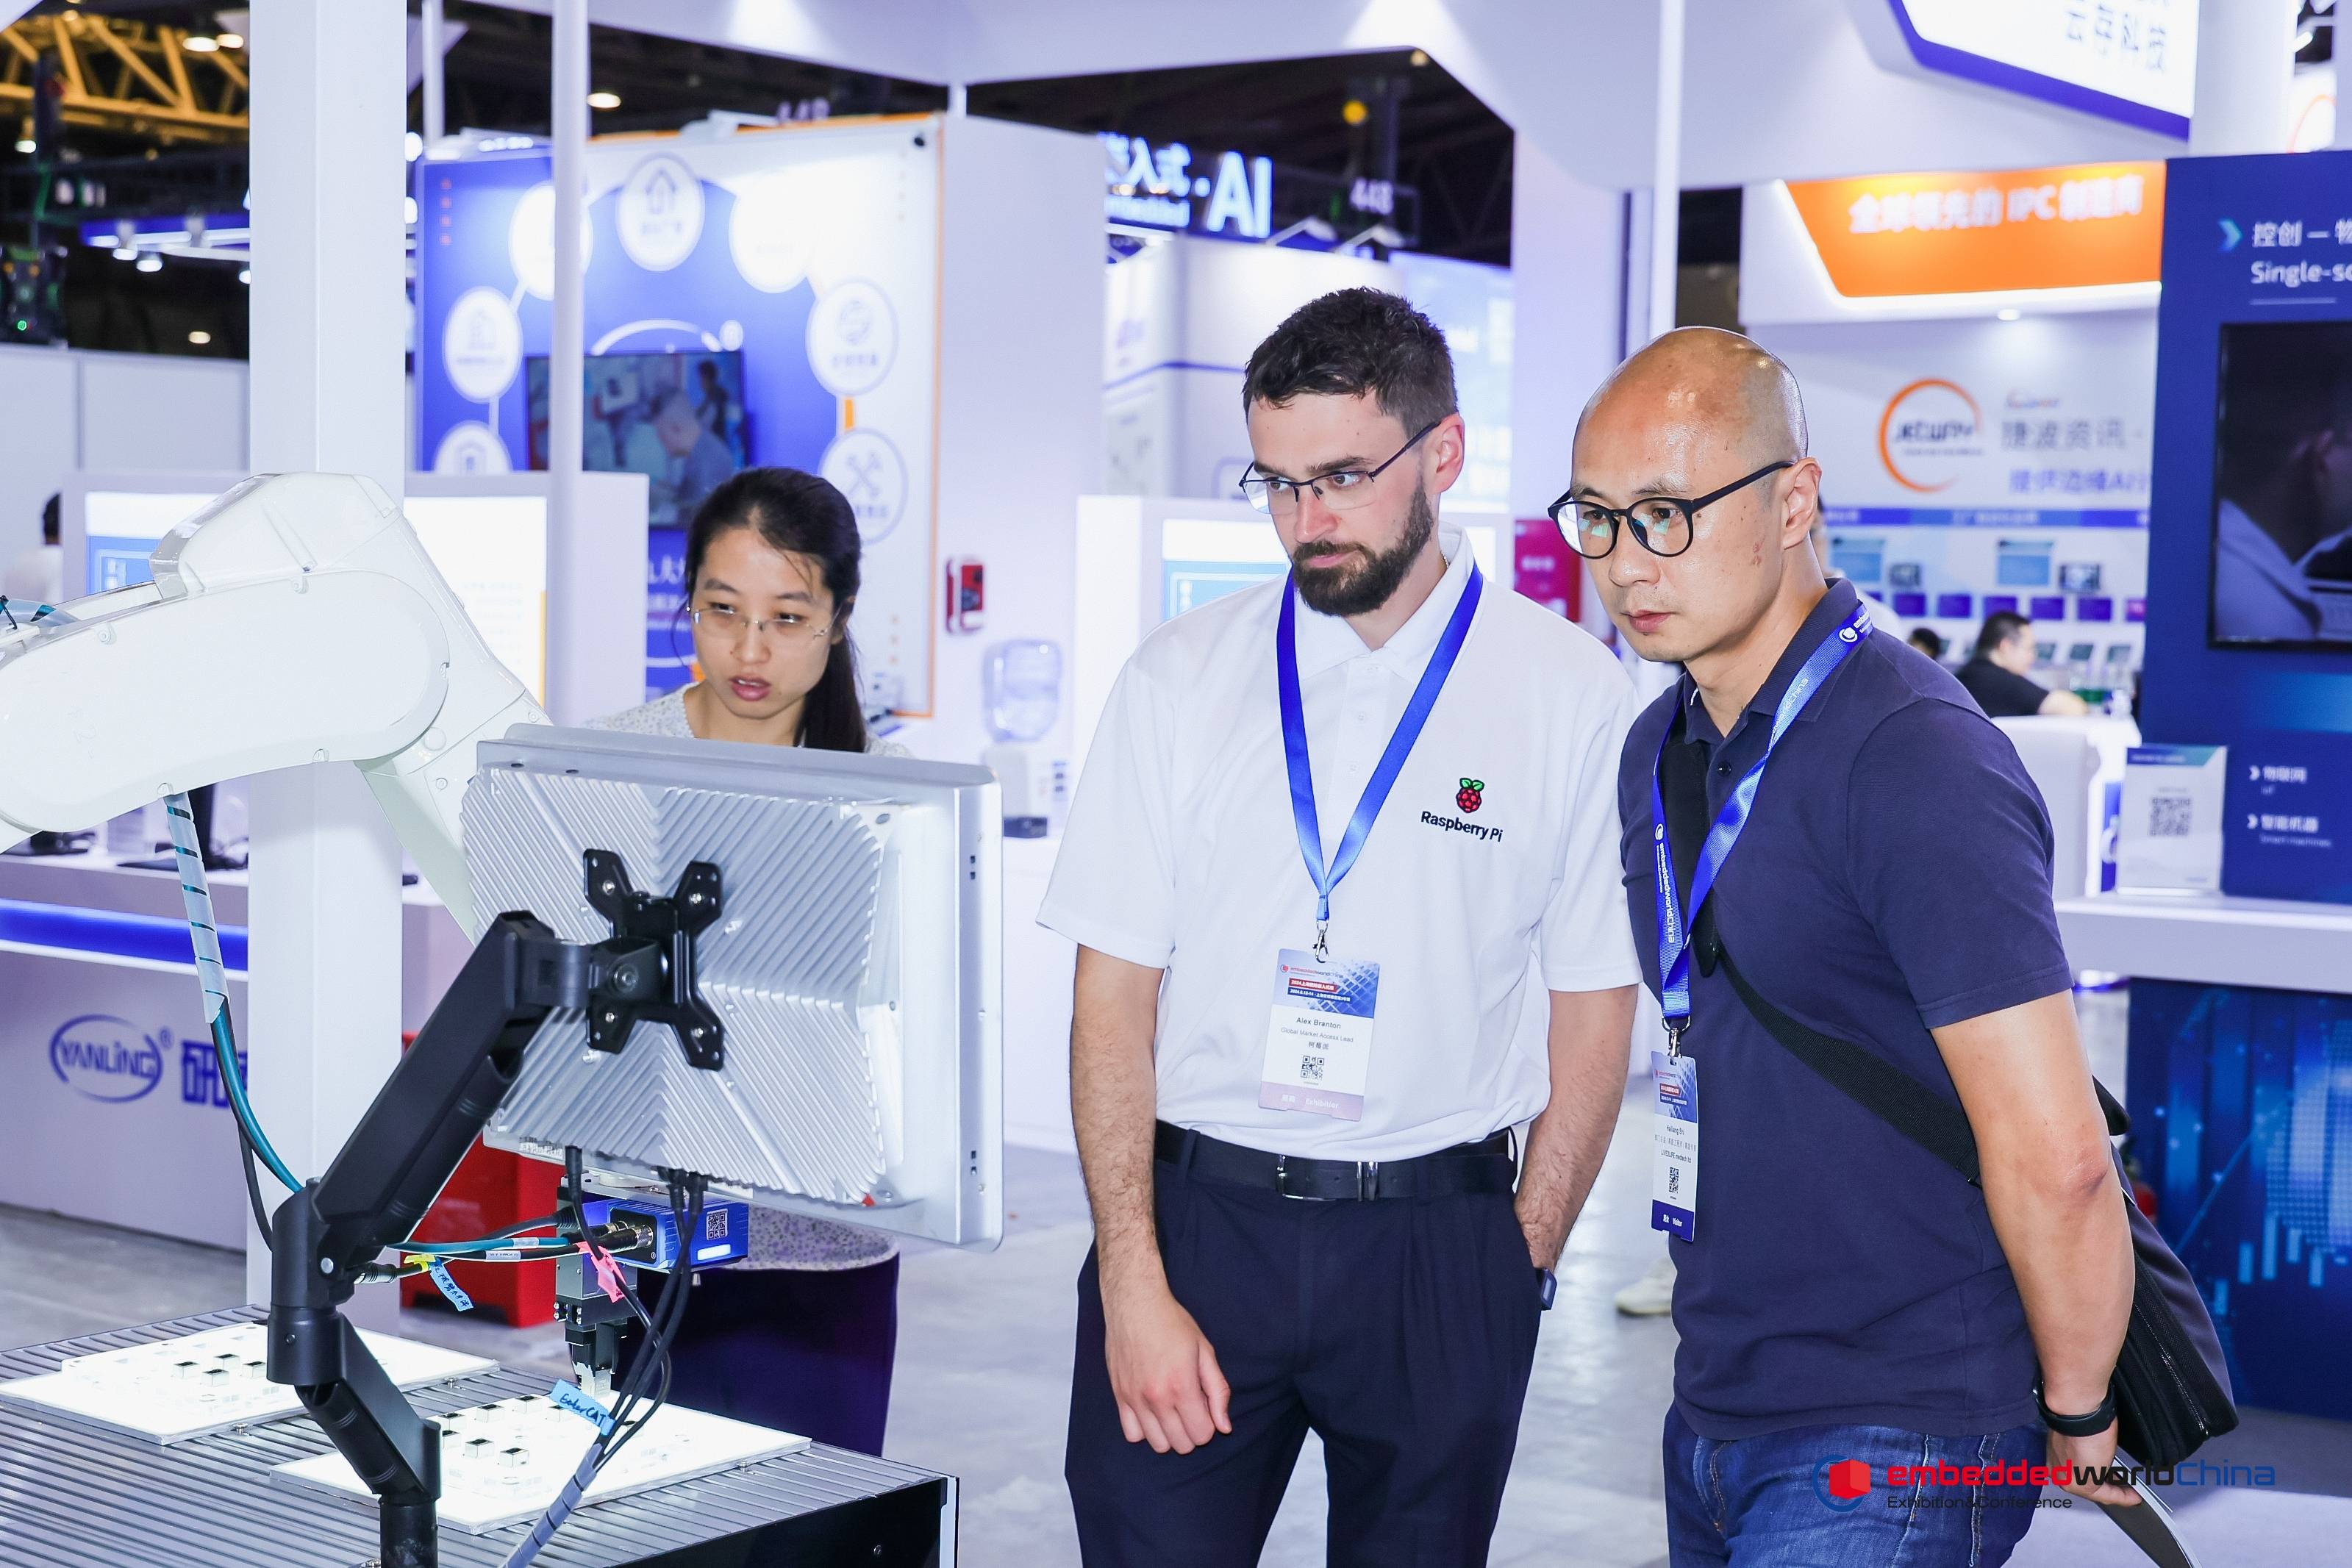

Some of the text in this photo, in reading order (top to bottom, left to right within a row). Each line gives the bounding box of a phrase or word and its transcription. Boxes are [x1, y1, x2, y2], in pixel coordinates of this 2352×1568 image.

[2252, 219, 2303, 248] 控创
[1420, 811, 1504, 842] Raspberry Pi
[1659, 842, 1675, 943] embeddedworldChina
[1296, 1017, 1341, 1029] Alex Branton
[1300, 1030, 1318, 1038] Market
